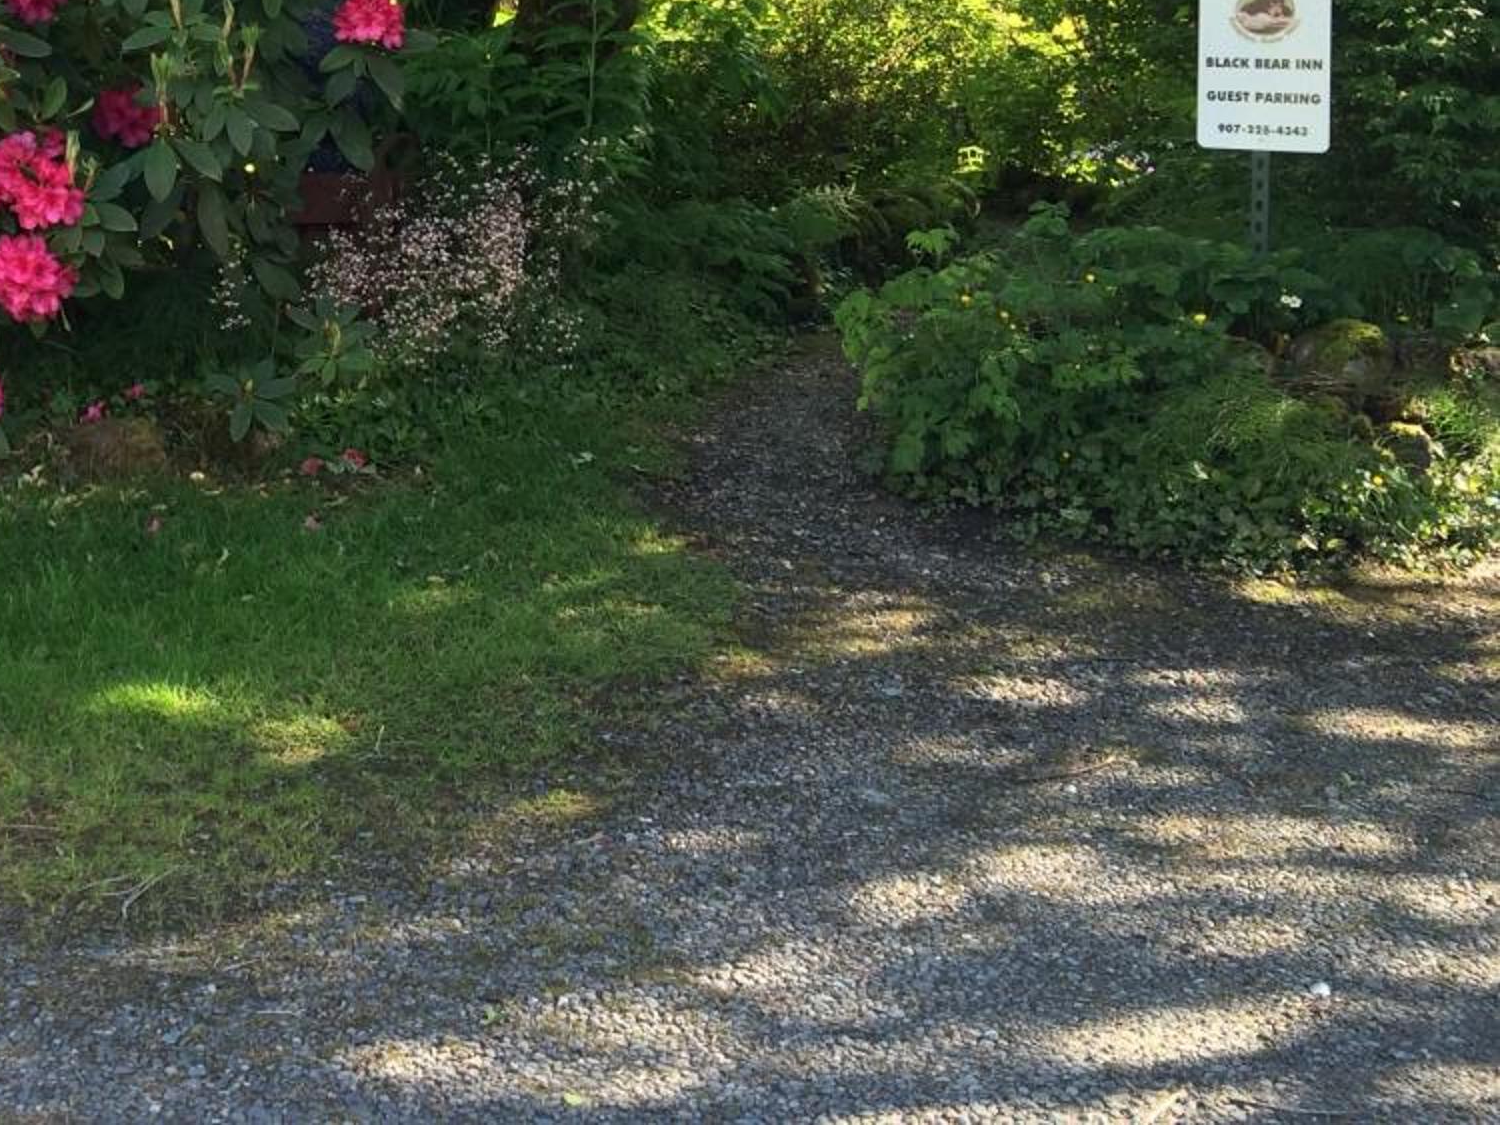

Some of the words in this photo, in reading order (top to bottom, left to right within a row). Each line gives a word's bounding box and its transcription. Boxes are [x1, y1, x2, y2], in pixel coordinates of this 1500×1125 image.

[1205, 56, 1249, 68] BLACK
[1255, 58, 1289, 69] BEAR
[1295, 59, 1323, 70] INN
[1206, 90, 1250, 102] GUEST
[1255, 92, 1322, 104] PARKING
